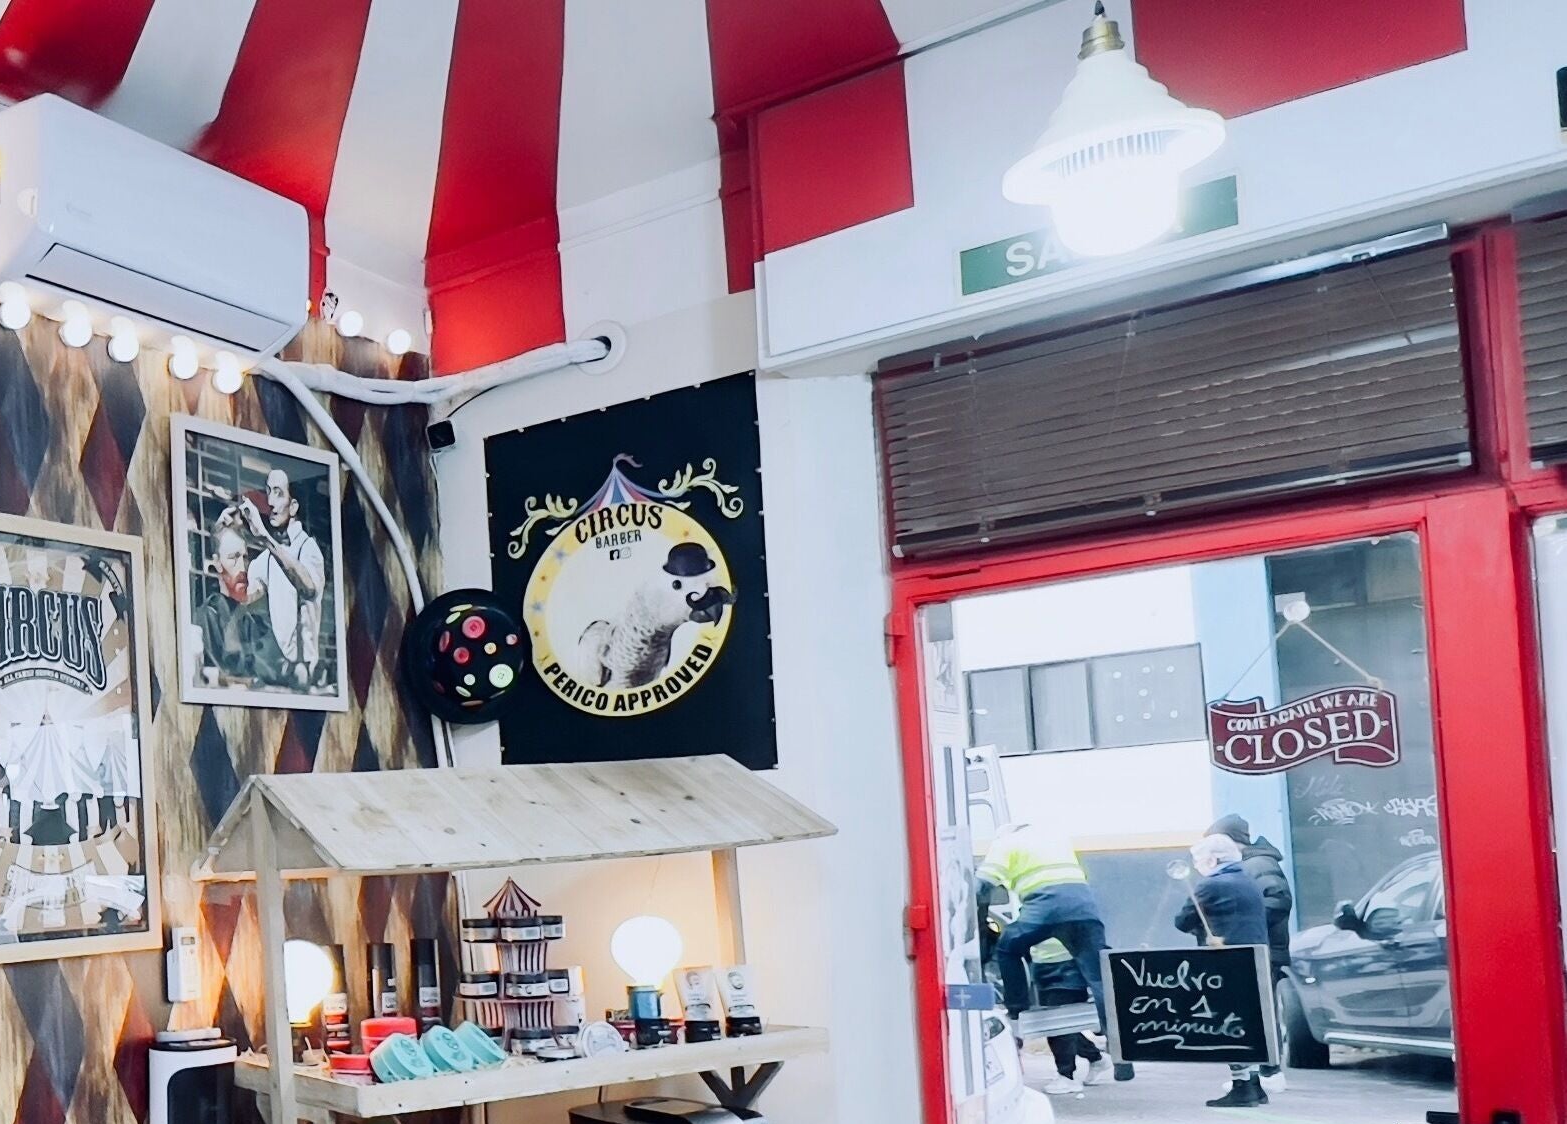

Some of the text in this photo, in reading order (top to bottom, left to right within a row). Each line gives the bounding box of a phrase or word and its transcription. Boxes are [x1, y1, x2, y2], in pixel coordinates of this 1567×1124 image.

[575, 503, 663, 544] CIRCUS
[595, 529, 642, 549] BARBER
[544, 643, 713, 712] PERICO APPROVED
[1226, 716, 1268, 732] COME
[1322, 693, 1344, 710] WE
[1346, 692, 1379, 708] ARE
[1224, 709, 1382, 766] CLOSED
[1132, 1011, 1246, 1038] minuto
[1189, 994, 1218, 1019] 1
